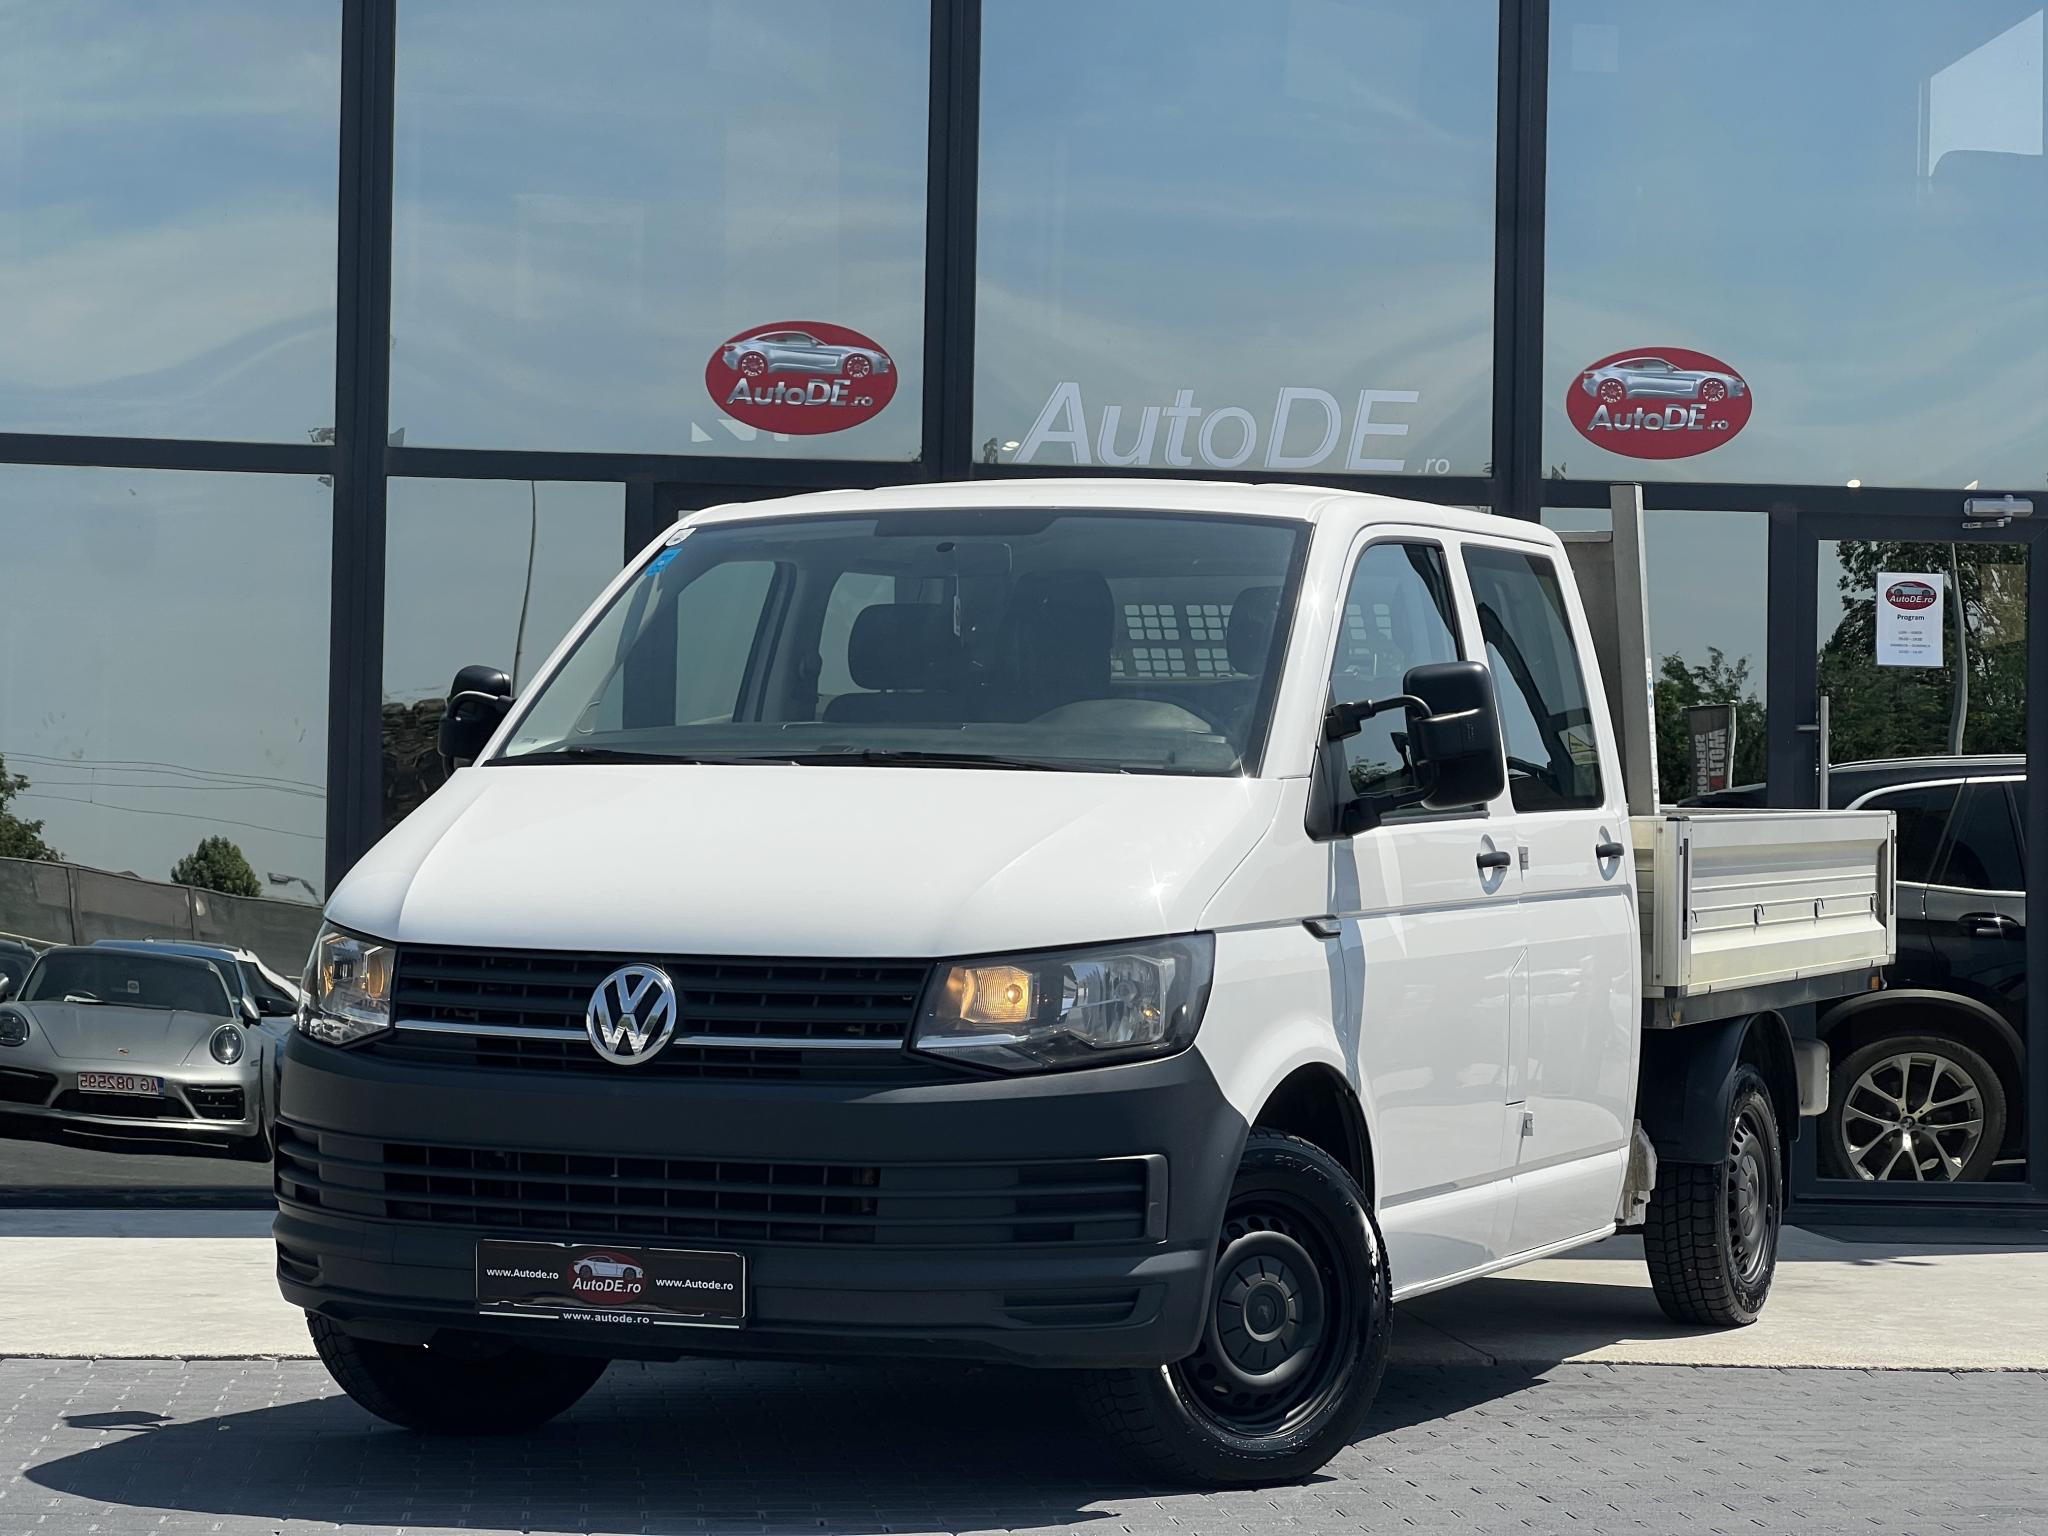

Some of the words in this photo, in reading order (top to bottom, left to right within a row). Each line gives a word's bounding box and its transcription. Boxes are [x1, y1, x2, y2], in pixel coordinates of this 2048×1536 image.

[588, 965, 675, 1063] VW
[486, 1267, 559, 1280] www.Autode.ro
[572, 1277, 642, 1293] AutoDE.ro
[655, 1277, 734, 1291] www.Autode.ro
[562, 1311, 650, 1325] www.autode.ro
